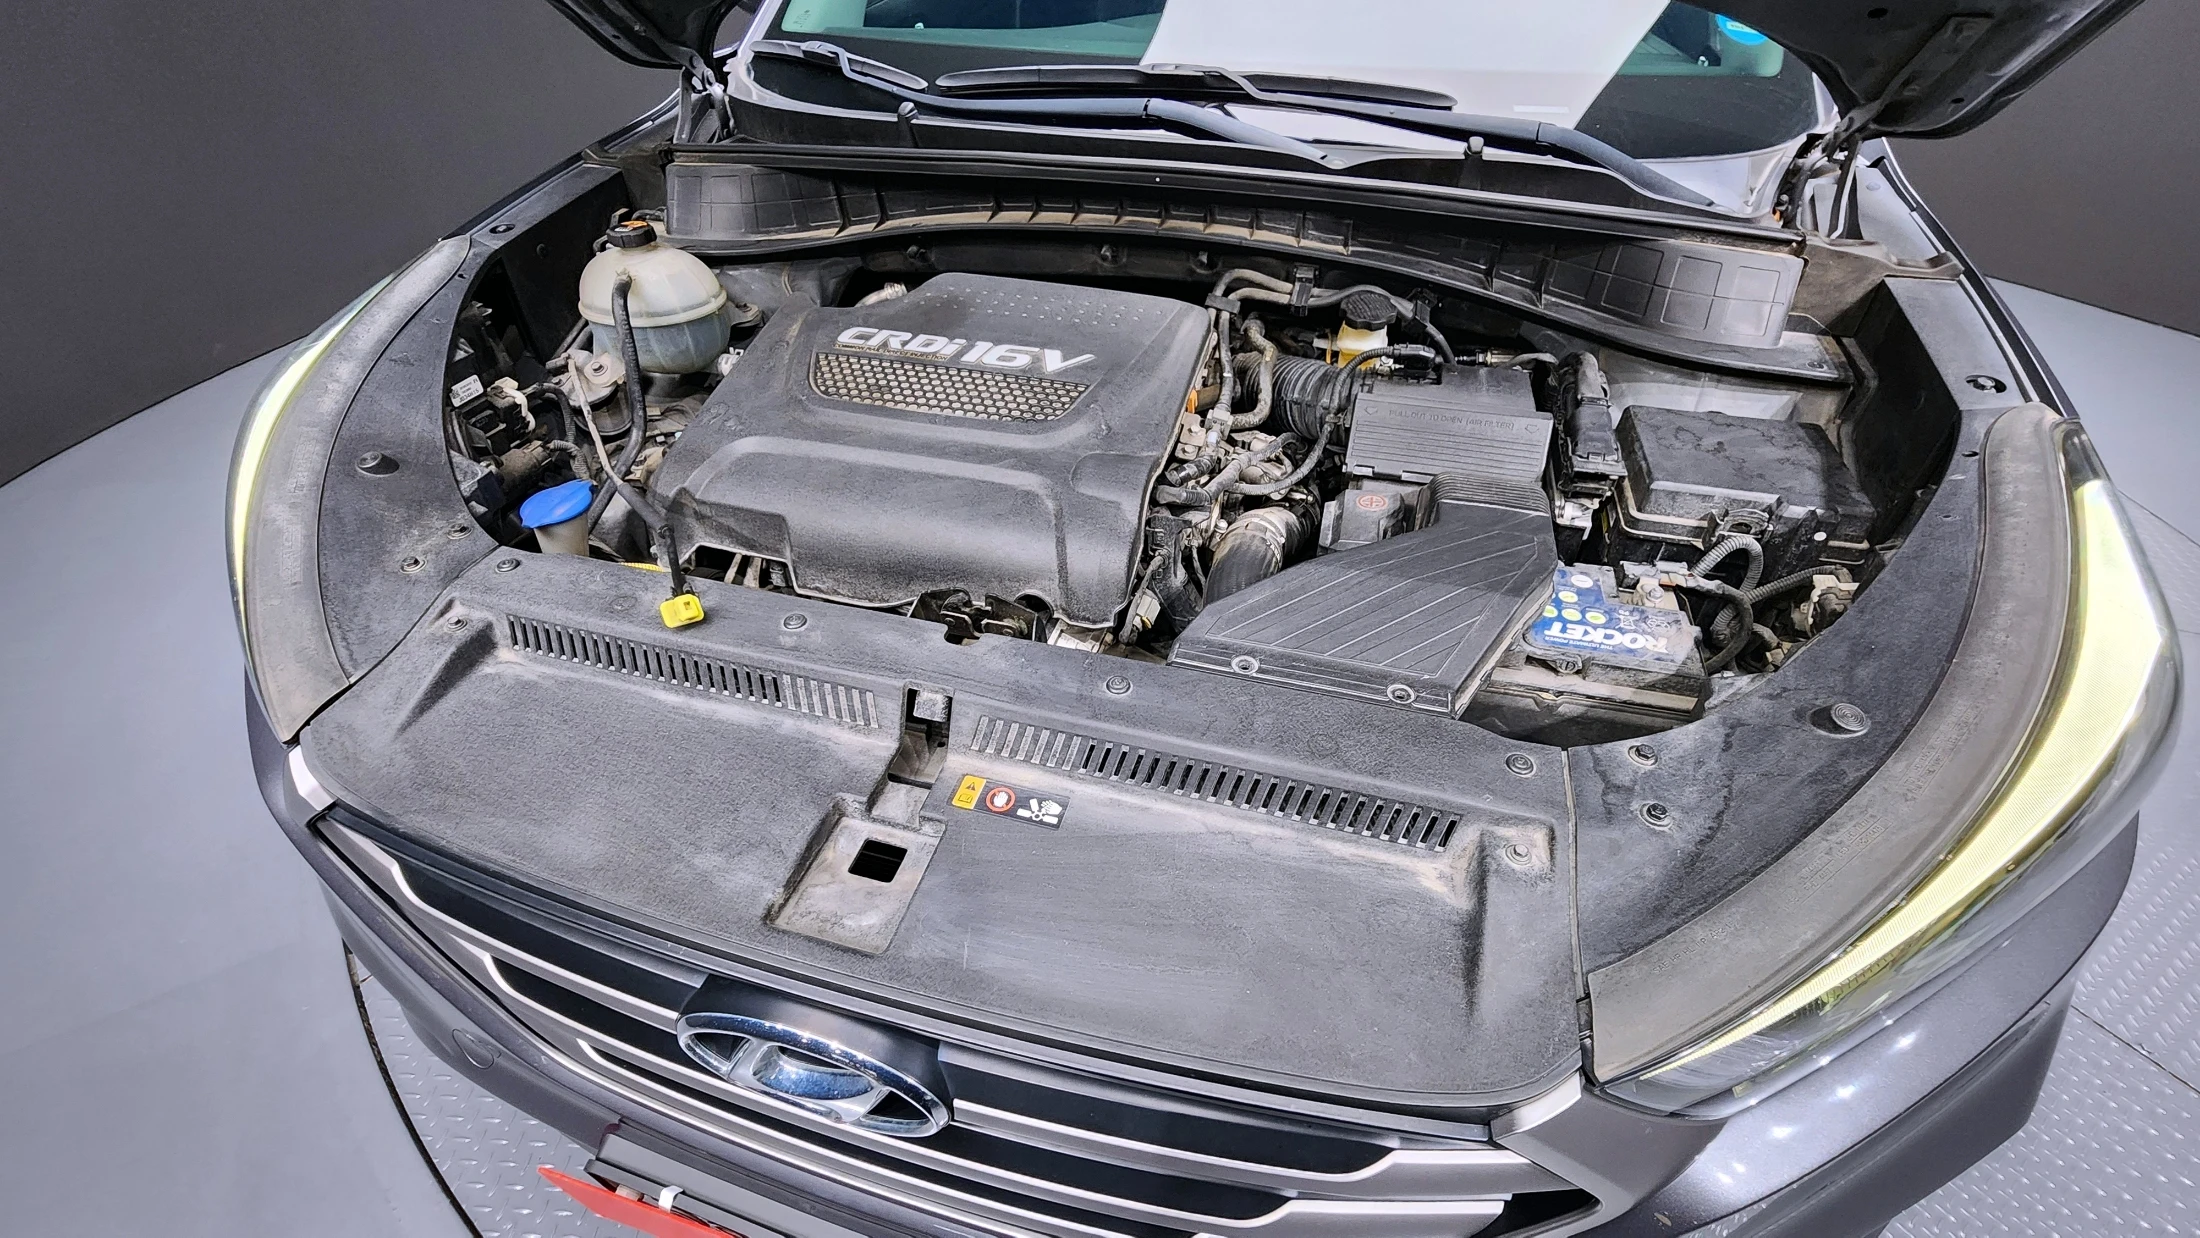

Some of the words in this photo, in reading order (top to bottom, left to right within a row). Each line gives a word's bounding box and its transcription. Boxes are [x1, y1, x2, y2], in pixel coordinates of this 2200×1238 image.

[833, 344, 865, 352] COMMON
[907, 352, 949, 361] INJECTION
[835, 327, 967, 359] CRDi
[959, 341, 1097, 373] 16V
[1389, 409, 1410, 419] PULL
[1411, 411, 1426, 420] OUT
[1441, 415, 1463, 424] OPEN
[1543, 621, 1670, 654] ROCKET
[1545, 636, 1569, 645] POWER
[1569, 639, 1600, 648] ULTIMATE
